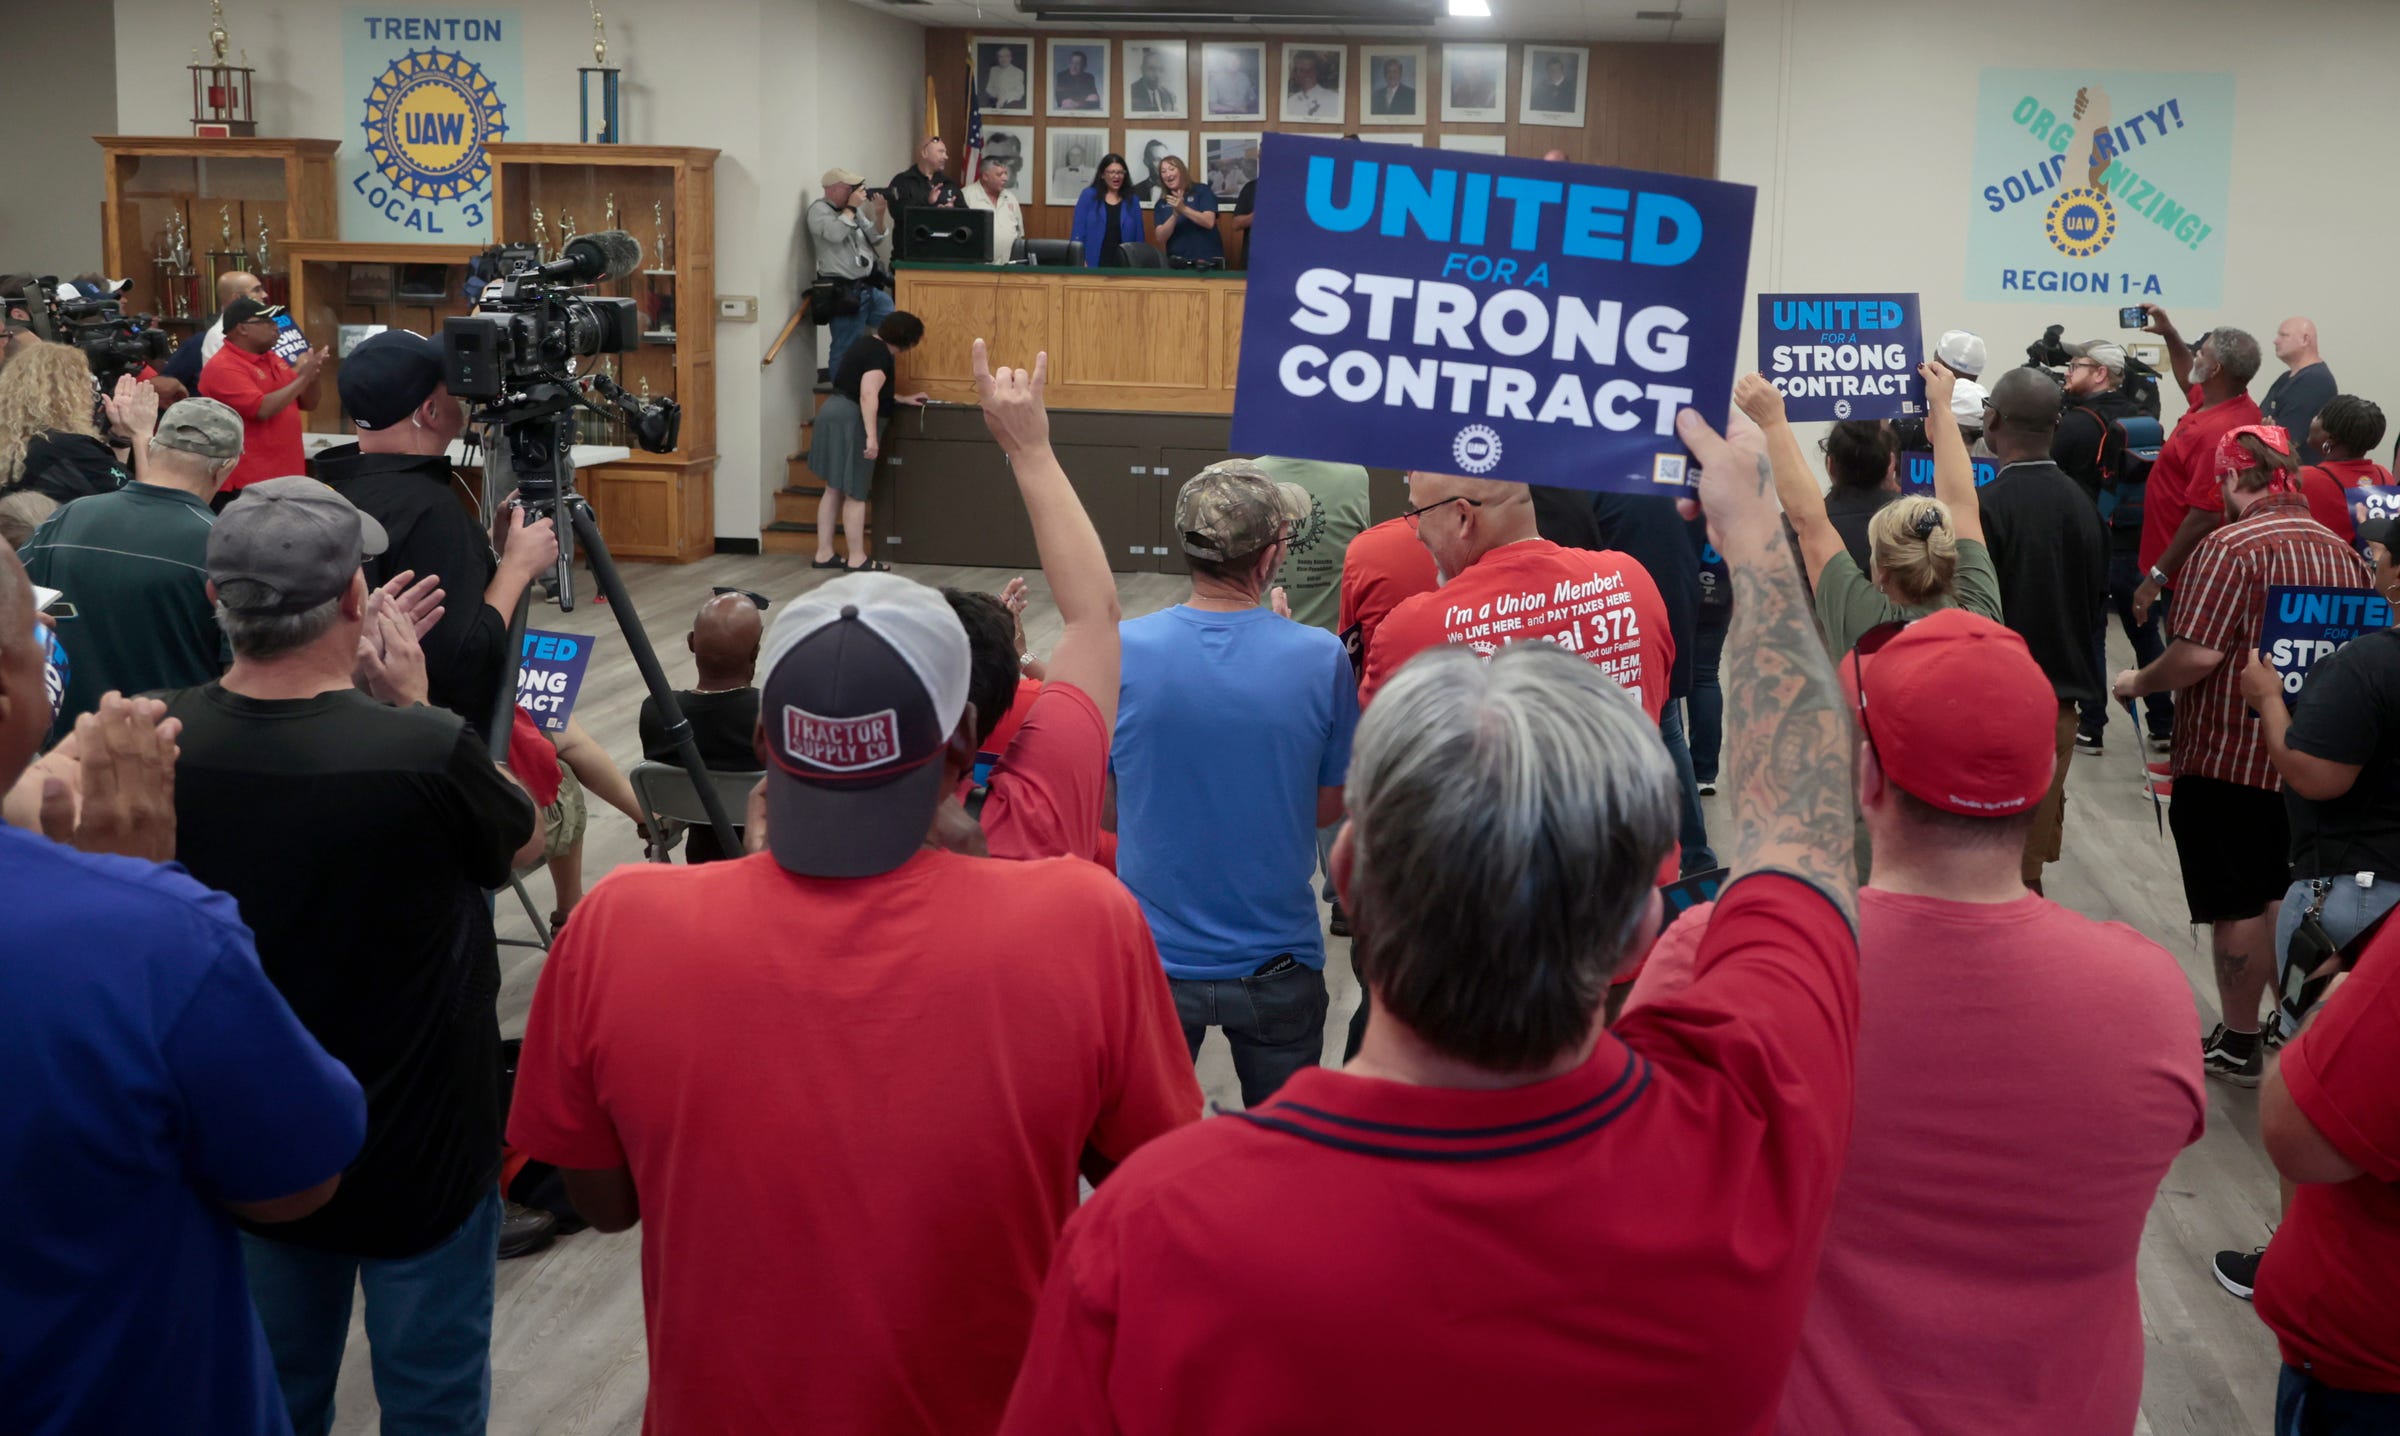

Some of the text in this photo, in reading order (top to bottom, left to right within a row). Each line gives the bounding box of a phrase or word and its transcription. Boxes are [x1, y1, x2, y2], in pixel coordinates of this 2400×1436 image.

[363, 16, 502, 42] TRENTON
[405, 112, 465, 146] UAW
[353, 170, 444, 233] LOCAL
[1305, 155, 1704, 267] UNITED
[2066, 217, 2095, 231] UAW
[1441, 253, 1550, 289] FOR A
[2002, 269, 2162, 295] REGION 1-A
[1290, 267, 1690, 373] STRONG
[1773, 300, 1905, 331] UNITED
[1820, 333, 1857, 344] FOR A
[1771, 343, 1907, 373] STRONG
[1278, 345, 1693, 437] CONTRACT
[1771, 374, 1911, 398] CONTRACT
[1467, 442, 1490, 456] UAW
[1445, 570, 1625, 629] I'm a Union Member!
[1447, 628, 1464, 644] We
[1465, 624, 1490, 640] LIVE
[1492, 617, 1524, 635] HERE,
[1527, 612, 1545, 628] and
[1547, 608, 1569, 623] PAY
[1571, 598, 1605, 618] TAXES
[1590, 606, 1640, 645] 372
[2323, 627, 2360, 640] FOR A
[522, 634, 579, 662] TED
[1600, 646, 1613, 656] our
[1613, 637, 1641, 654] Families!
[2272, 638, 2350, 668] STR
[1597, 653, 1642, 675] BLEM,
[1610, 668, 1642, 686] EMY!
[791, 714, 887, 745] TRACTOR
[792, 738, 857, 763] SUPPLY
